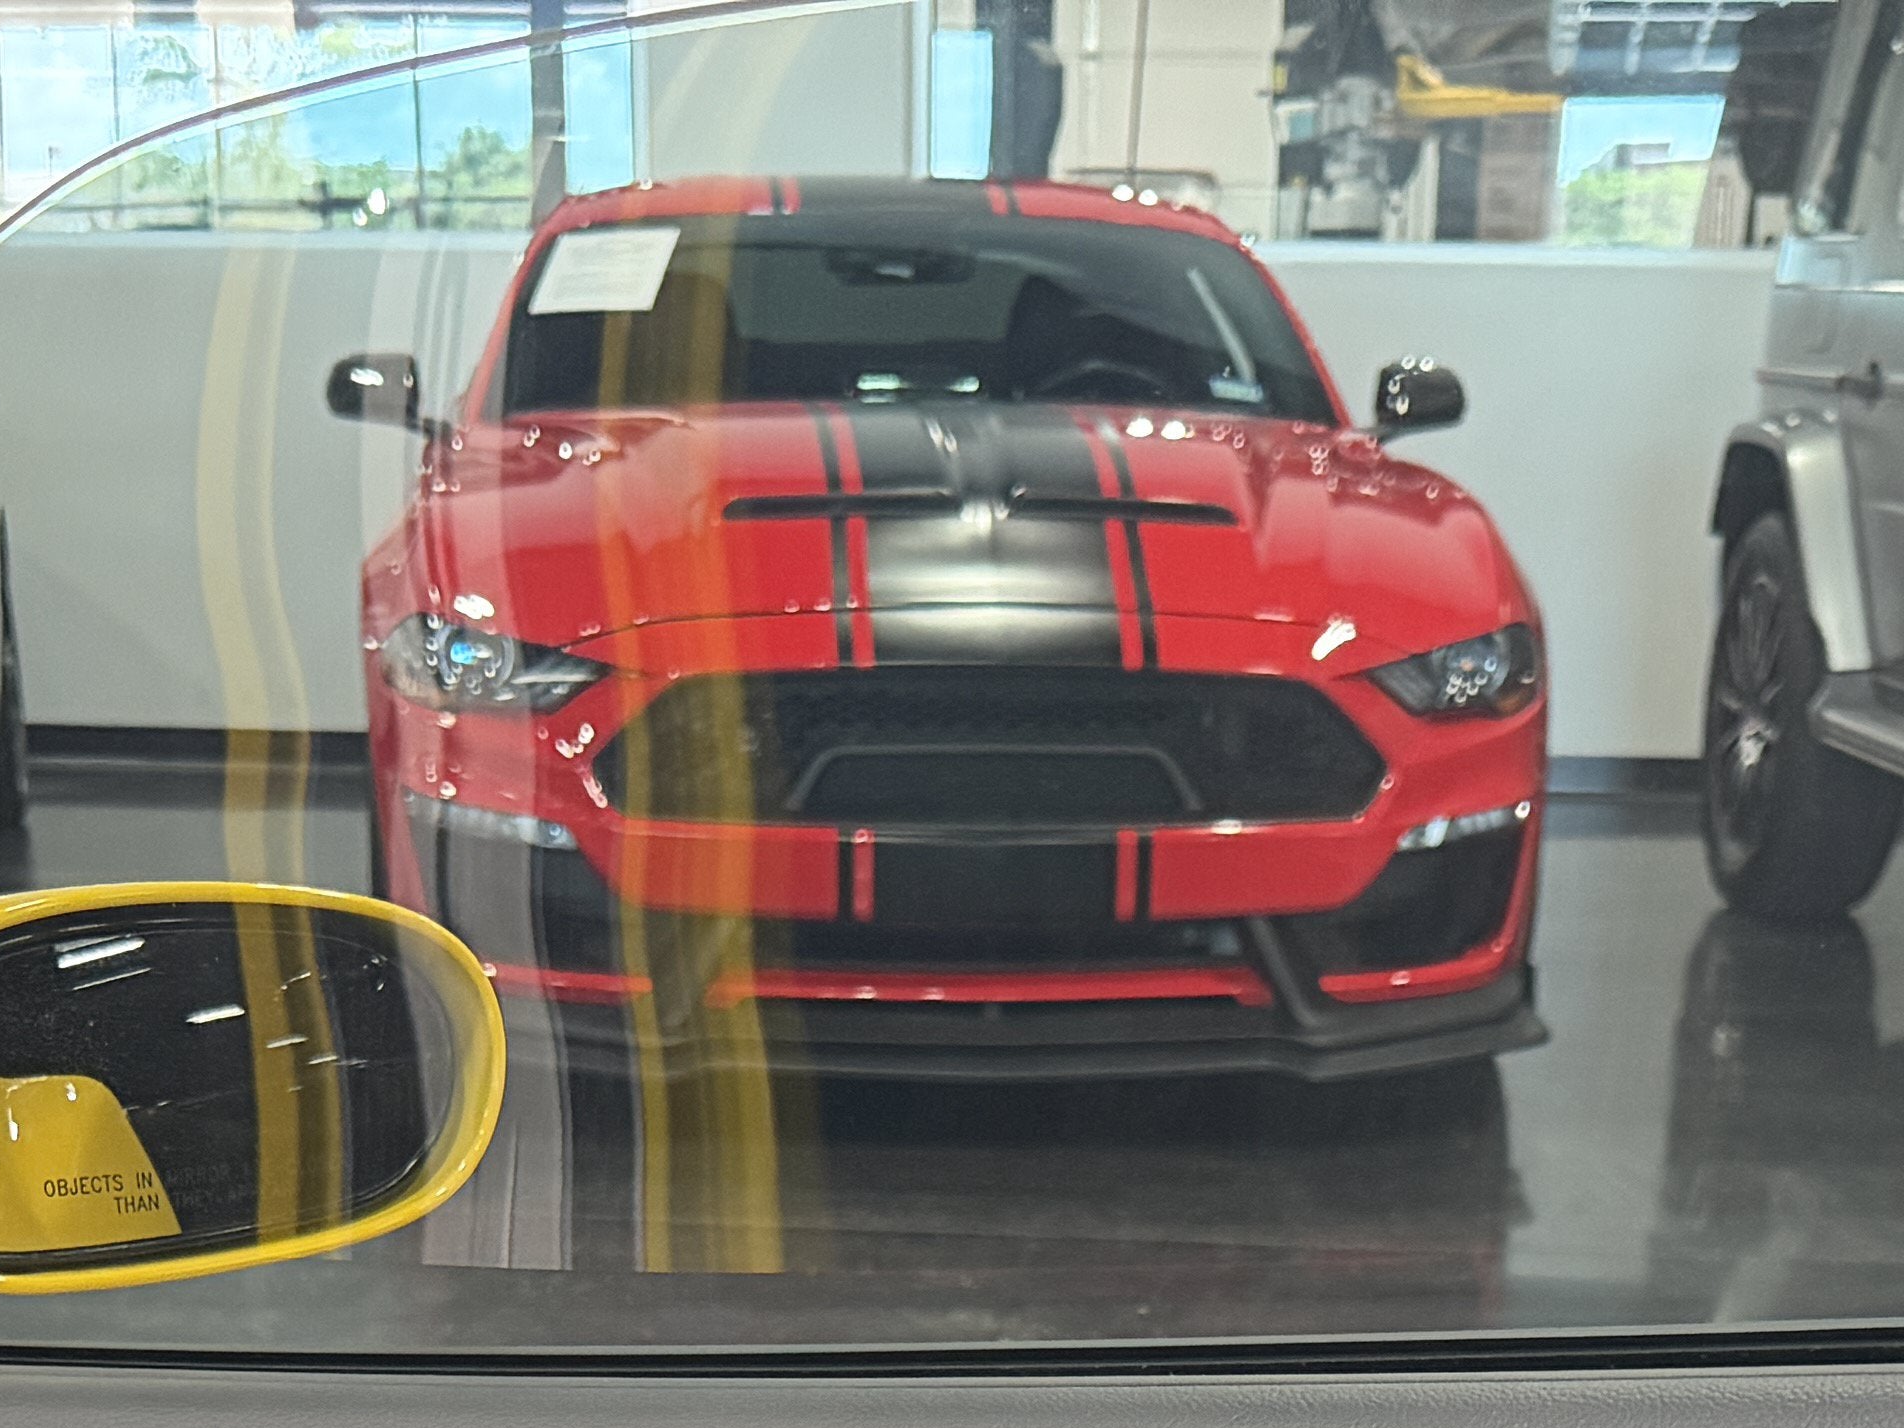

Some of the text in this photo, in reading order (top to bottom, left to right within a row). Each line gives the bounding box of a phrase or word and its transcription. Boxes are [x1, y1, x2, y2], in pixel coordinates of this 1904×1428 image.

[43, 1173, 125, 1198] OBJECTS
[135, 1171, 153, 1190] IN
[113, 1194, 160, 1215] THAN
